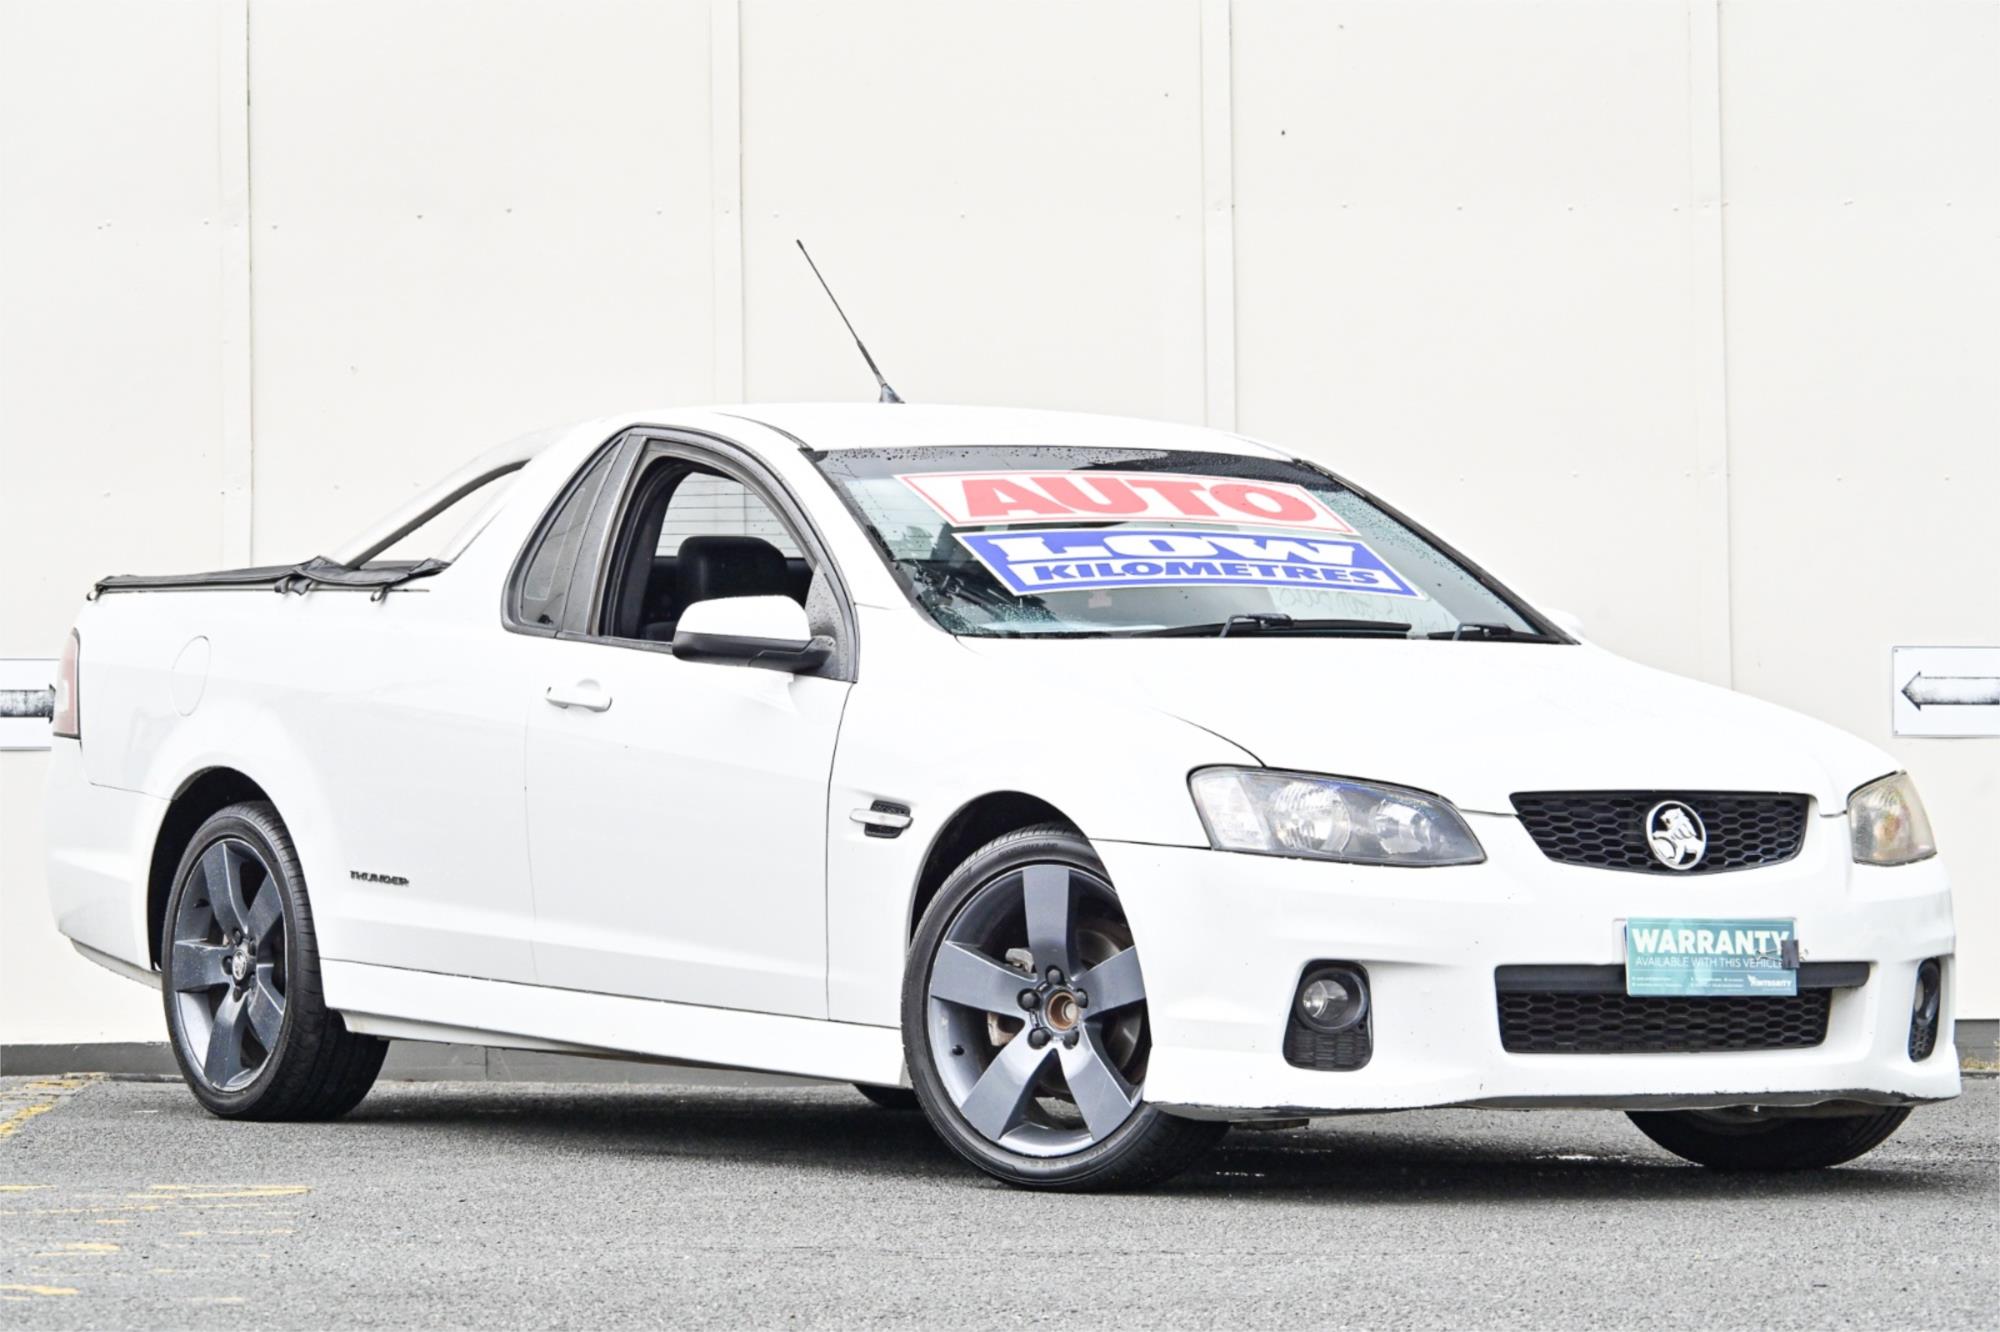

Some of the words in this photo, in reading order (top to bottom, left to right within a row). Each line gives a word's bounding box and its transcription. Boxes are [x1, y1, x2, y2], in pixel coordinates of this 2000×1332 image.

[962, 477, 1317, 521] AUTO
[989, 534, 1356, 565] LOW
[1034, 561, 1380, 585] KILOMETRES
[1631, 927, 1790, 955] WARRANTY
[1636, 956, 1689, 968] AVAILABLE
[1691, 957, 1718, 968] WITH
[1719, 957, 1741, 968] THIS
